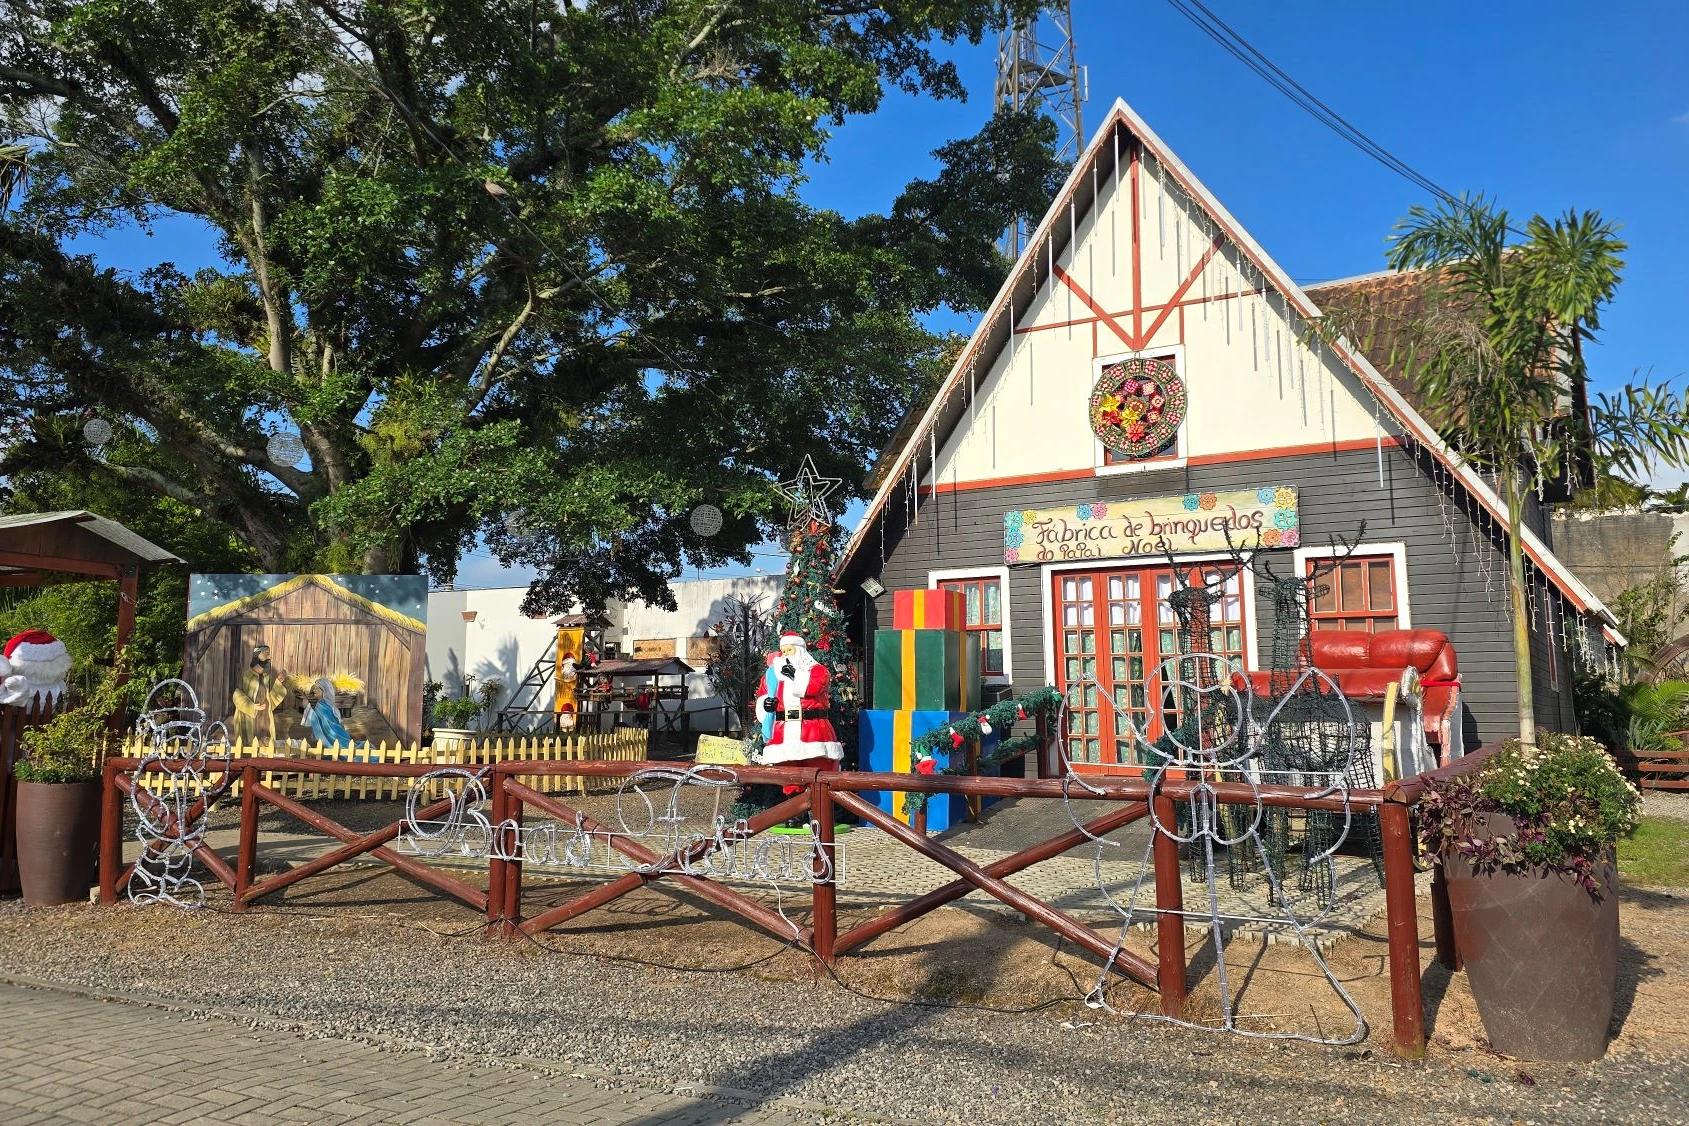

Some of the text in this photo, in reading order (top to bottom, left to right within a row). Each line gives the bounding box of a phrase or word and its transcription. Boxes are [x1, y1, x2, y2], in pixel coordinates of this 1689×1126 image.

[1032, 505, 1264, 545] Fábrica de brinquedos
[1037, 544, 1054, 560] do
[1122, 538, 1178, 555] Noel
[404, 764, 833, 884] Boas Festas
